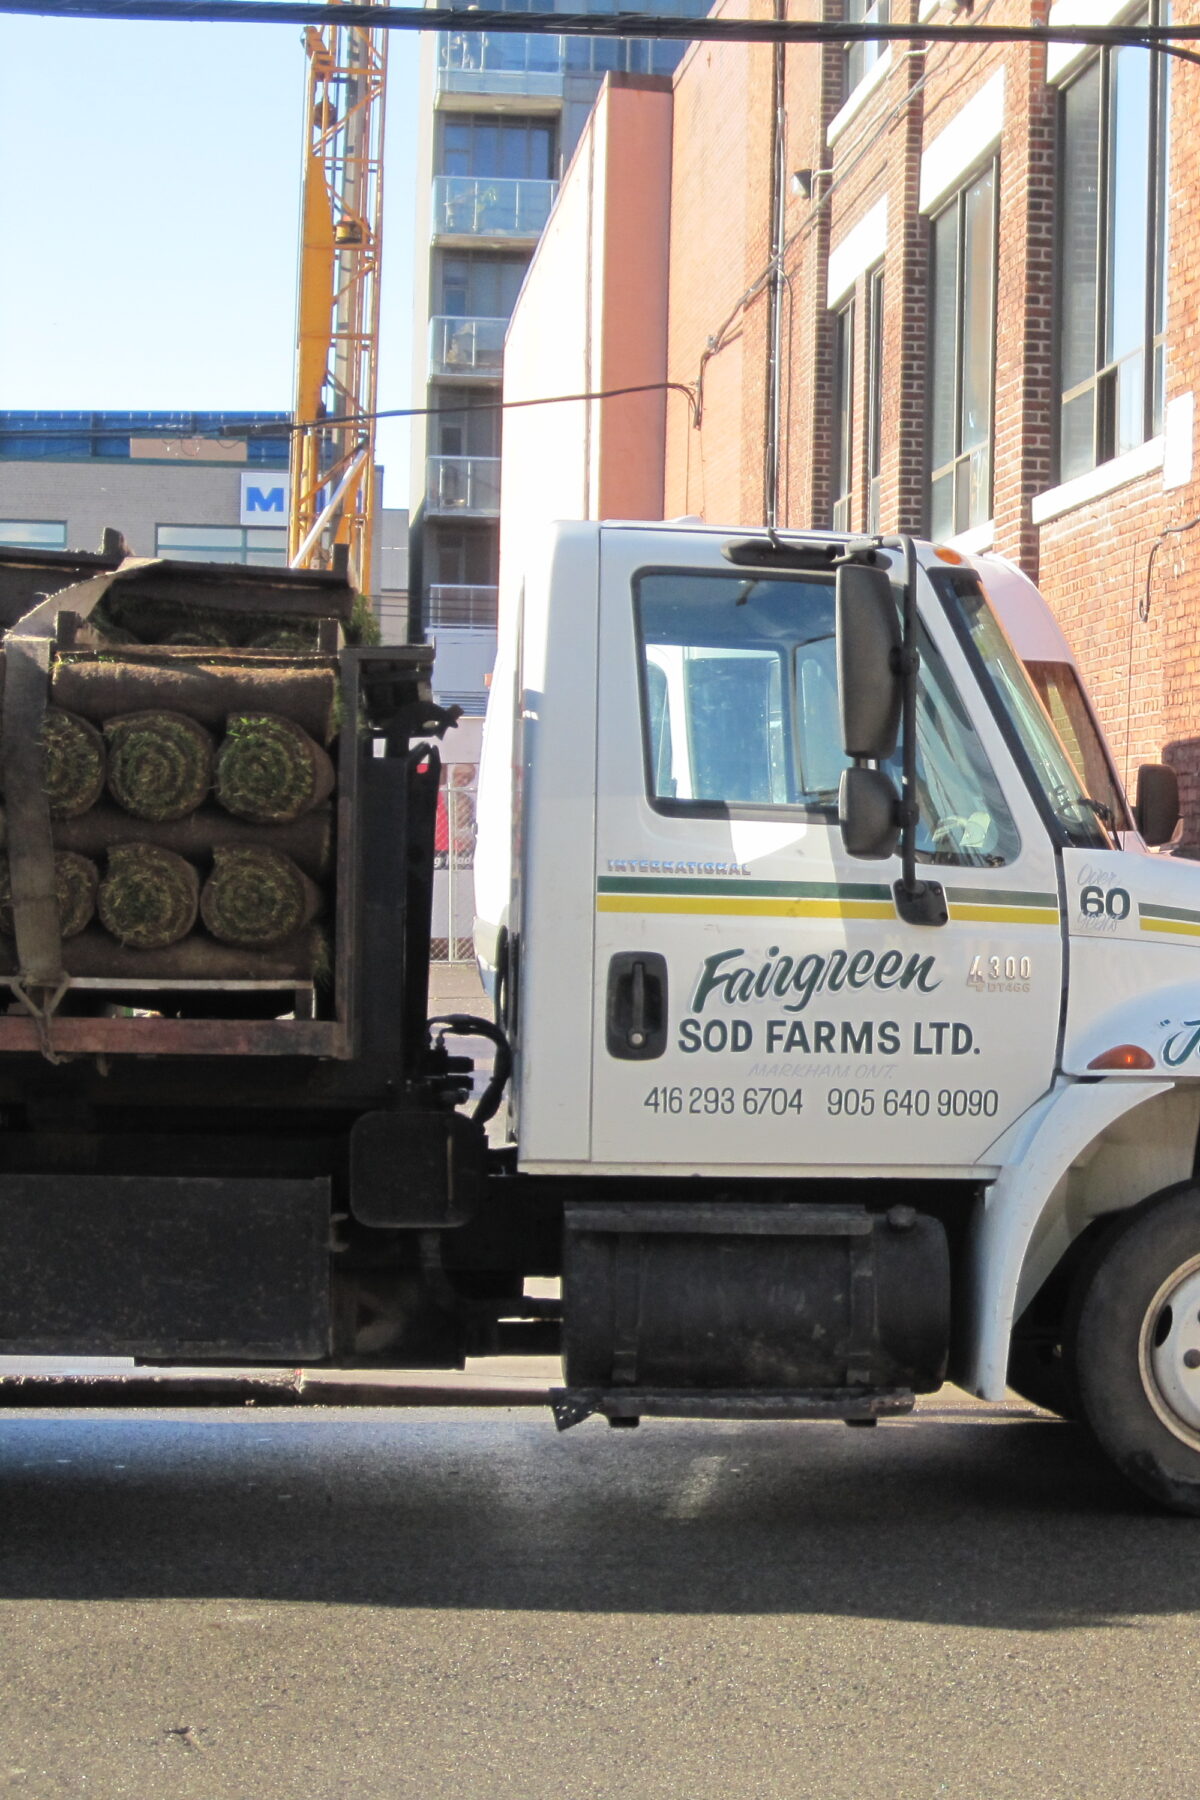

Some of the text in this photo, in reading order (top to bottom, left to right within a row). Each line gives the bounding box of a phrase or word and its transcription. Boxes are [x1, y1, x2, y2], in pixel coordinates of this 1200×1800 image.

[607, 859, 751, 875] INTERNATIONAL
[1080, 886, 1131, 920] 60
[692, 946, 943, 1013] Fairgreen
[966, 955, 1031, 992] 4300
[678, 1019, 981, 1055] SOD FARMS LTD.
[747, 1063, 851, 1078] MARKHAM
[644, 1087, 999, 1117] 416 293 6704 905 640 9090
